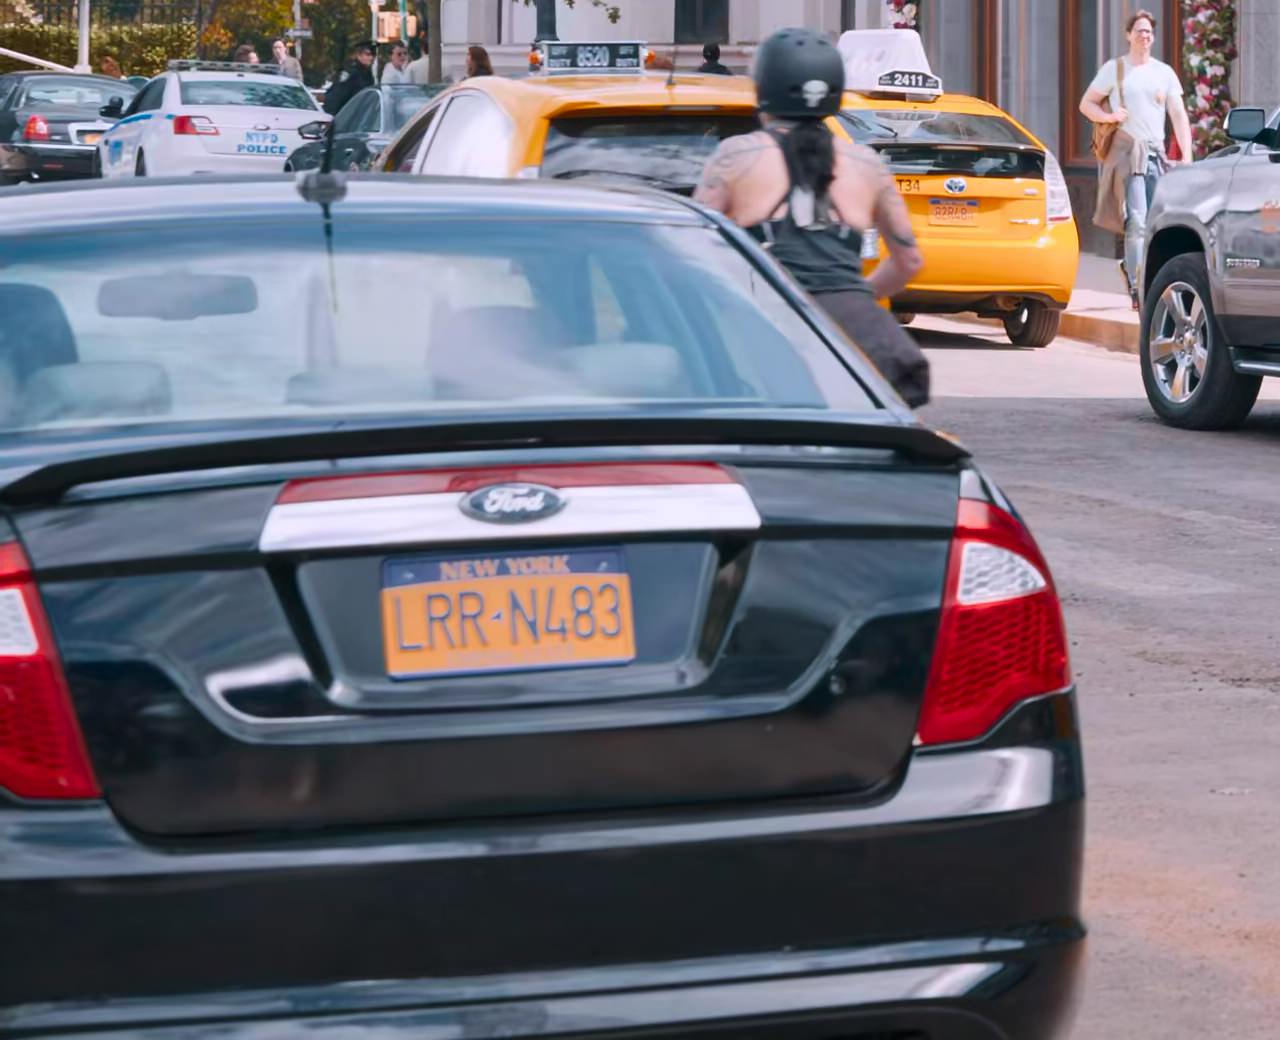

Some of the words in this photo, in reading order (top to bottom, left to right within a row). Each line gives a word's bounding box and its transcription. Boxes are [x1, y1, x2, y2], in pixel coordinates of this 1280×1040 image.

[577, 46, 609, 66] 8520
[893, 73, 923, 86] 2411
[245, 132, 279, 144] NYPD
[236, 144, 287, 155] POLICE
[483, 487, 545, 513] Ford
[440, 559, 500, 580] NEW
[505, 554, 571, 576] YORK
